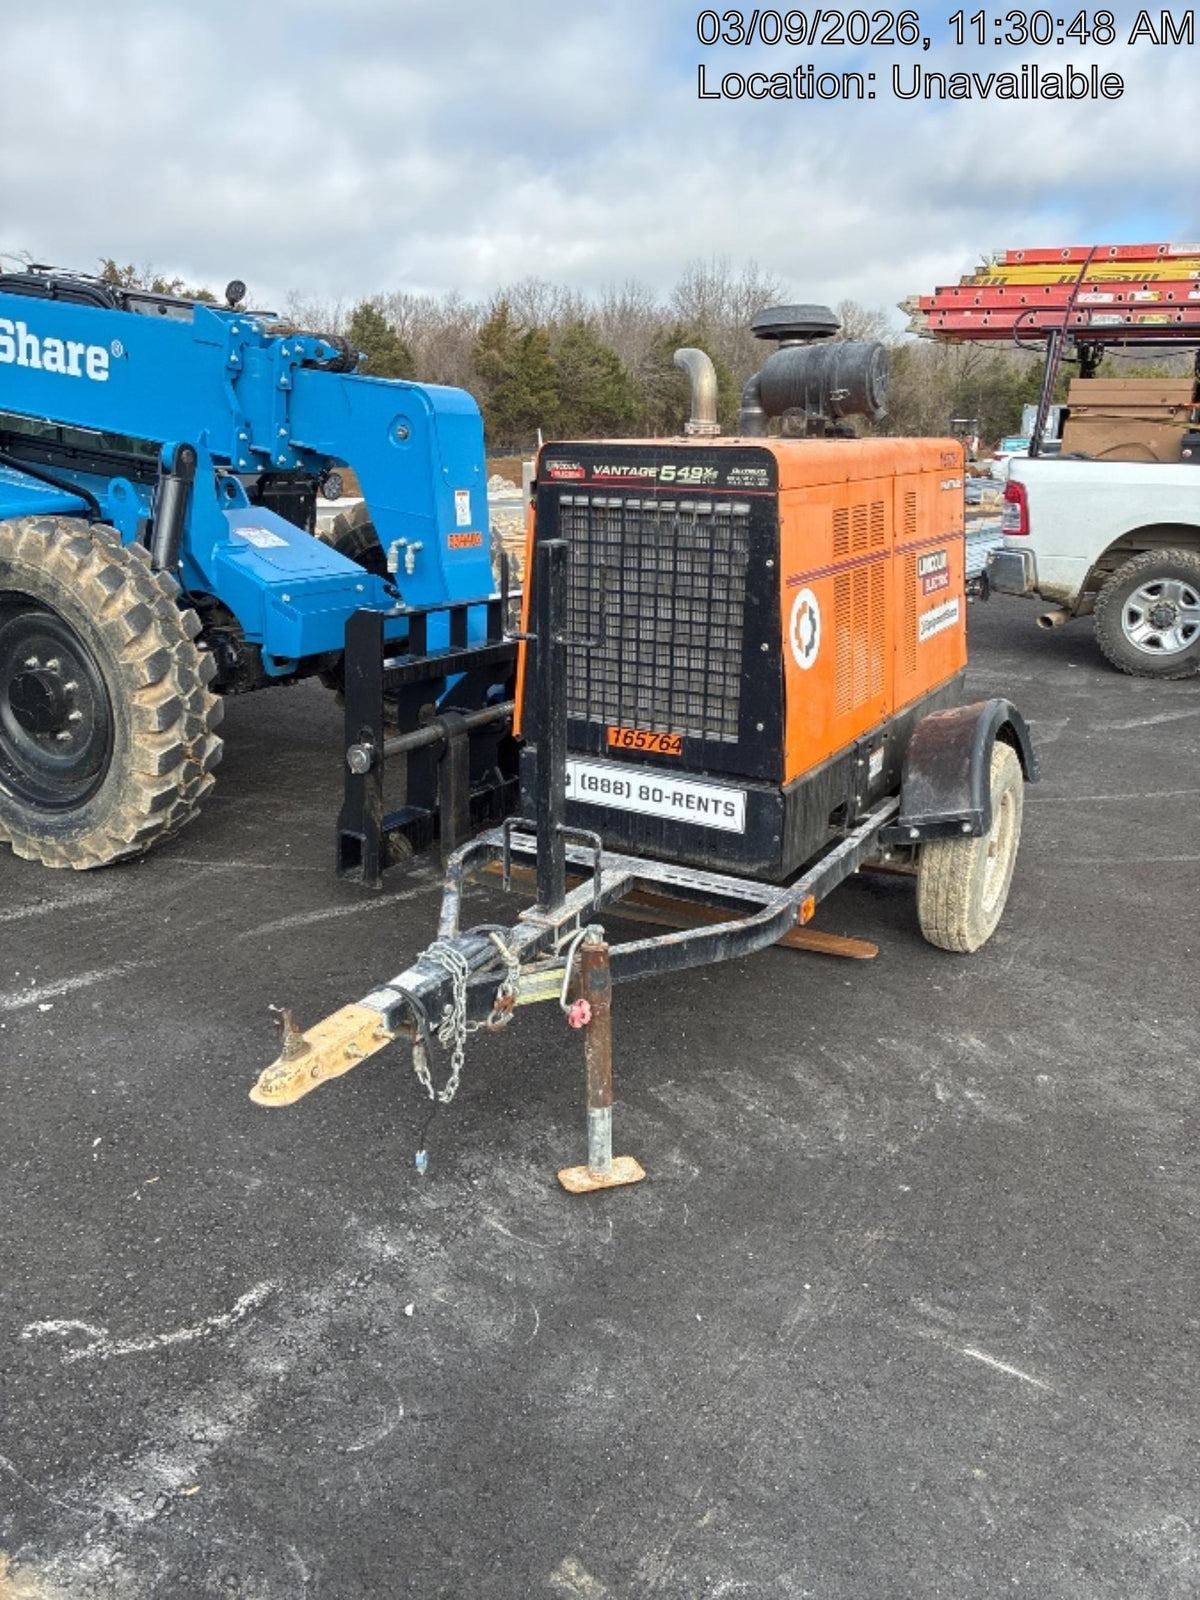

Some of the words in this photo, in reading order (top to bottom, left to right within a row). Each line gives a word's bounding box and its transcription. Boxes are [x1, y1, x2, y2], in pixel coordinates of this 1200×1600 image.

[0, 317, 109, 382] Share
[592, 464, 658, 478] VANTAGE
[613, 728, 682, 753] 165764
[580, 772, 631, 799] (888)
